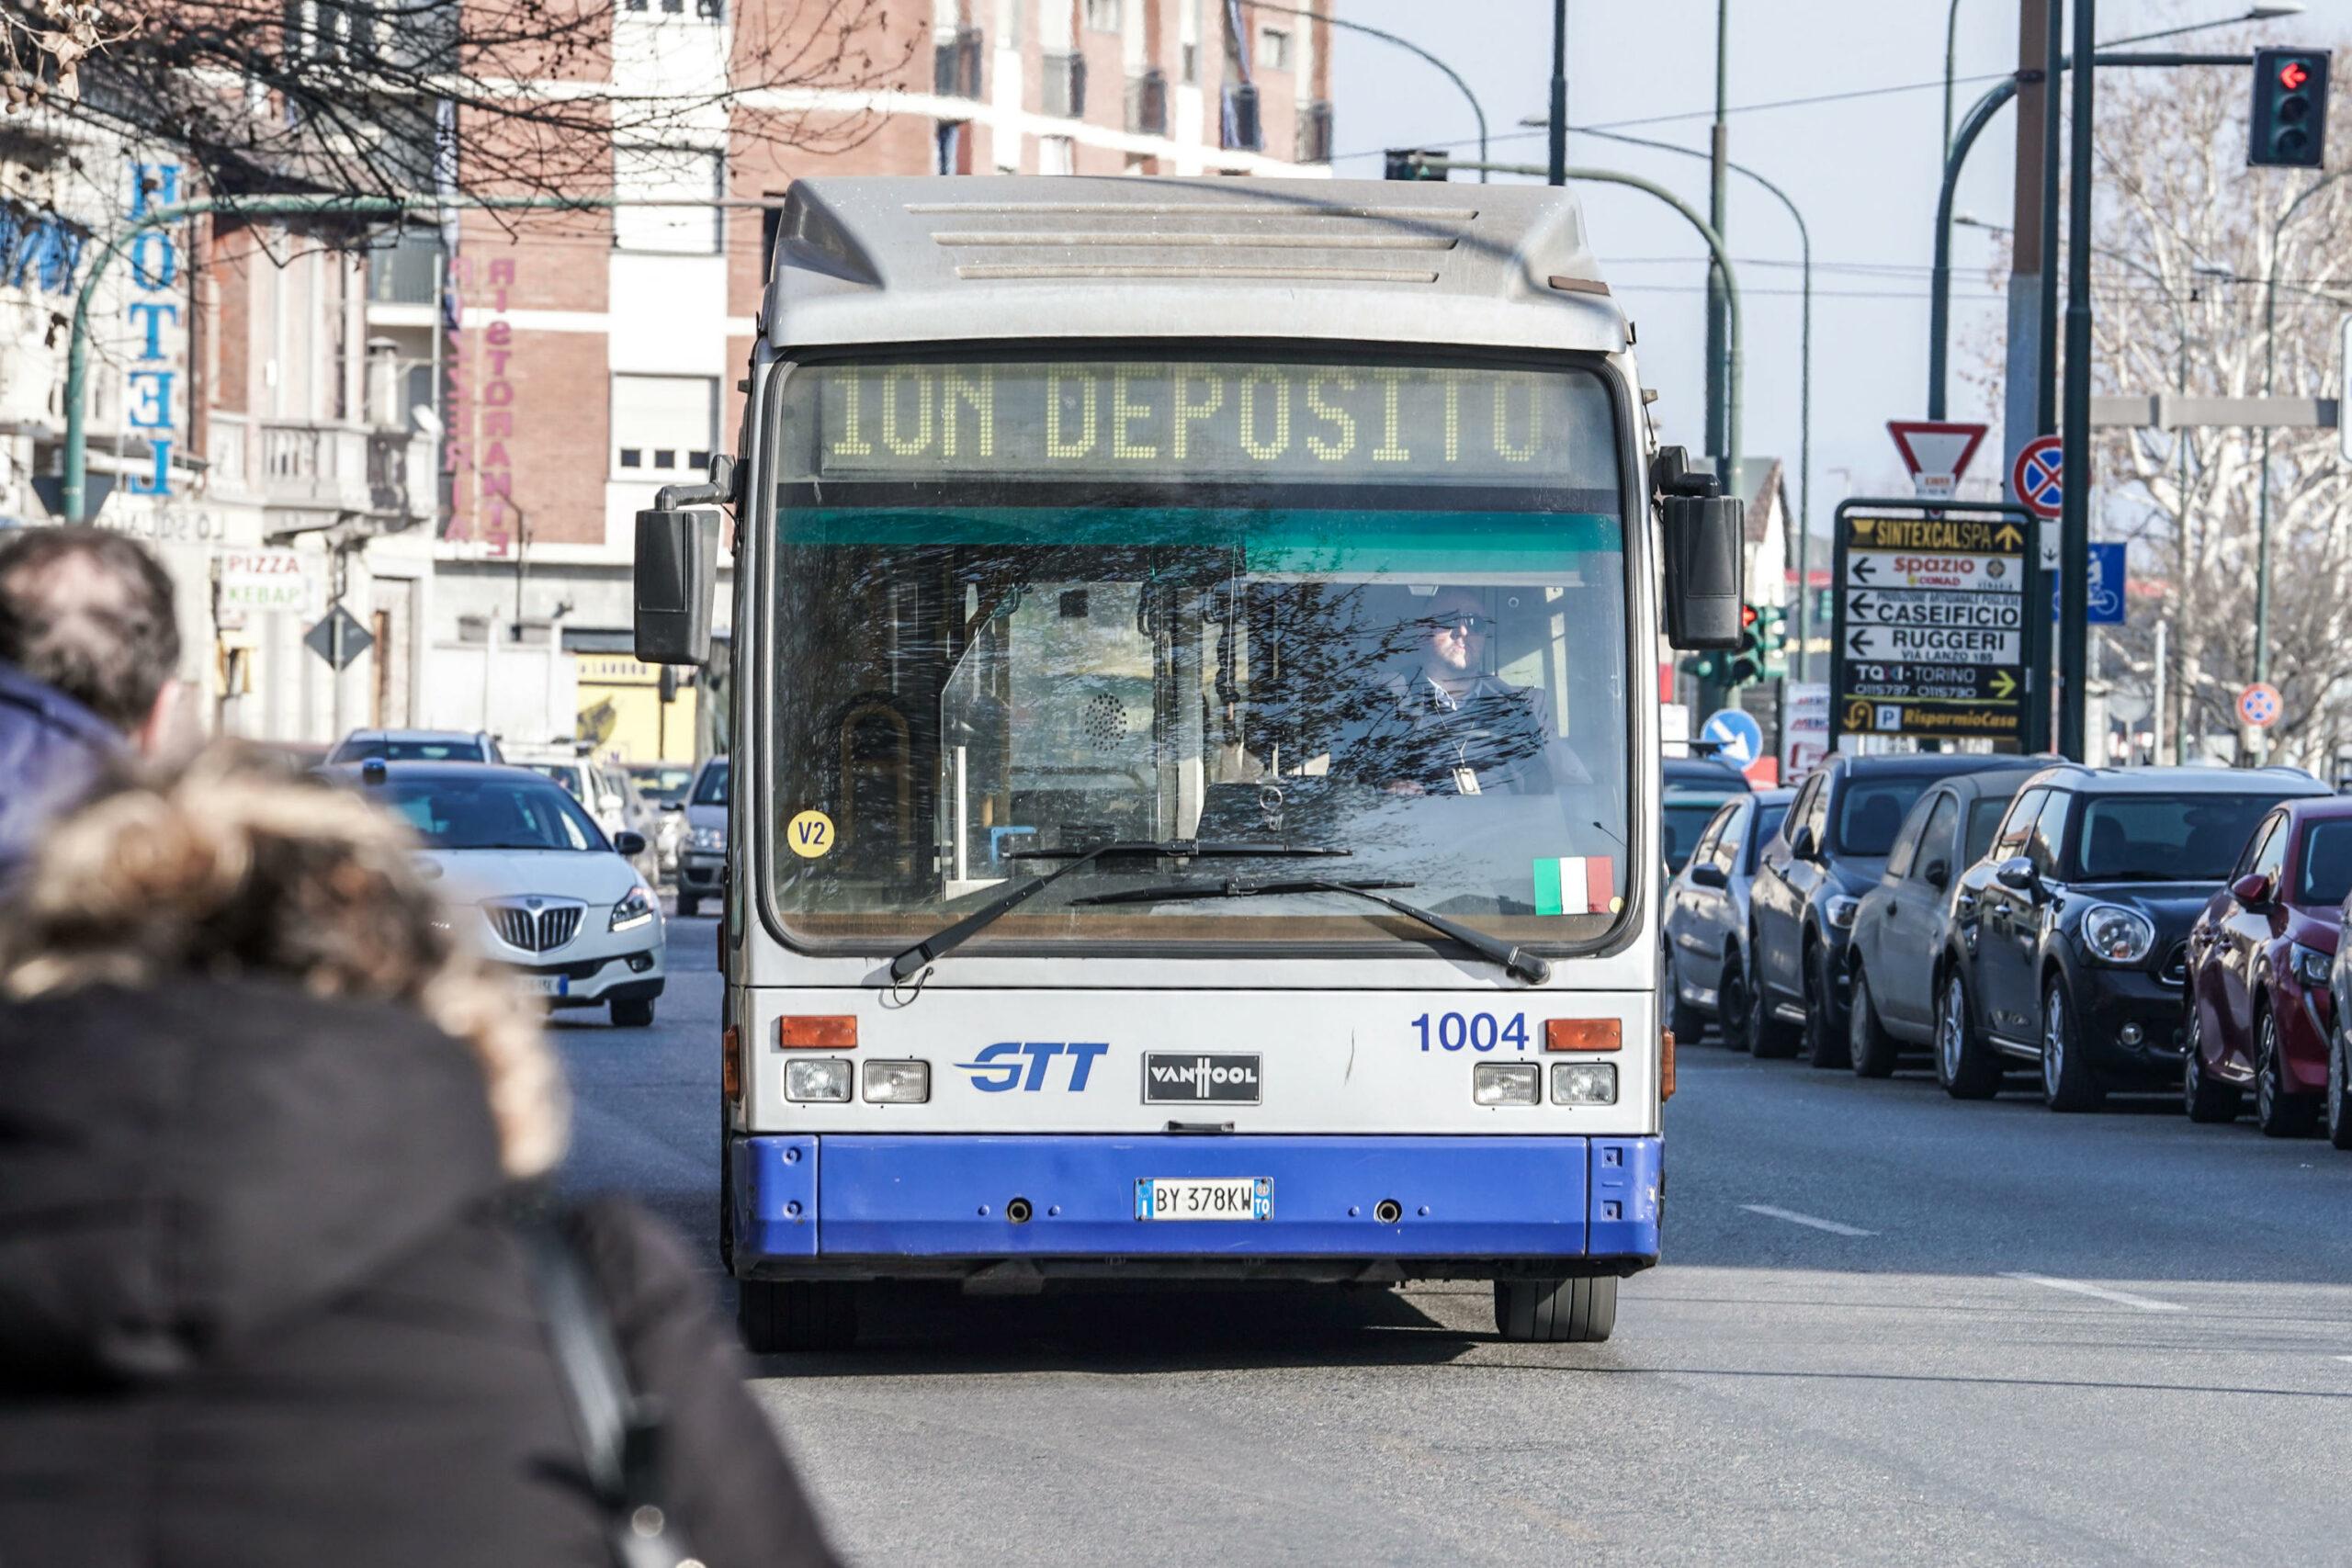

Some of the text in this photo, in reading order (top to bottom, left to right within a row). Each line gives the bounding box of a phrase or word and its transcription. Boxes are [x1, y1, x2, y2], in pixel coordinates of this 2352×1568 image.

[1046, 365, 1543, 463] DEPOSITO
[229, 555, 300, 574] PIZZA
[1894, 556, 1975, 574] spazio
[1877, 604, 2018, 626] CASEIFICIO
[1893, 630, 2005, 650] RUGGERI
[1902, 650, 1921, 660] VIA
[1926, 651, 1970, 661] LANZO
[1913, 666, 1975, 683] TORINO
[1903, 709, 2018, 728] RisparmioCasa
[798, 821, 825, 845] V2
[1411, 1011, 1531, 1052] 1004
[952, 1042, 1111, 1093] GTT
[1157, 1186, 1252, 1212] BY 378KW
[1255, 1199, 1270, 1214] TO
